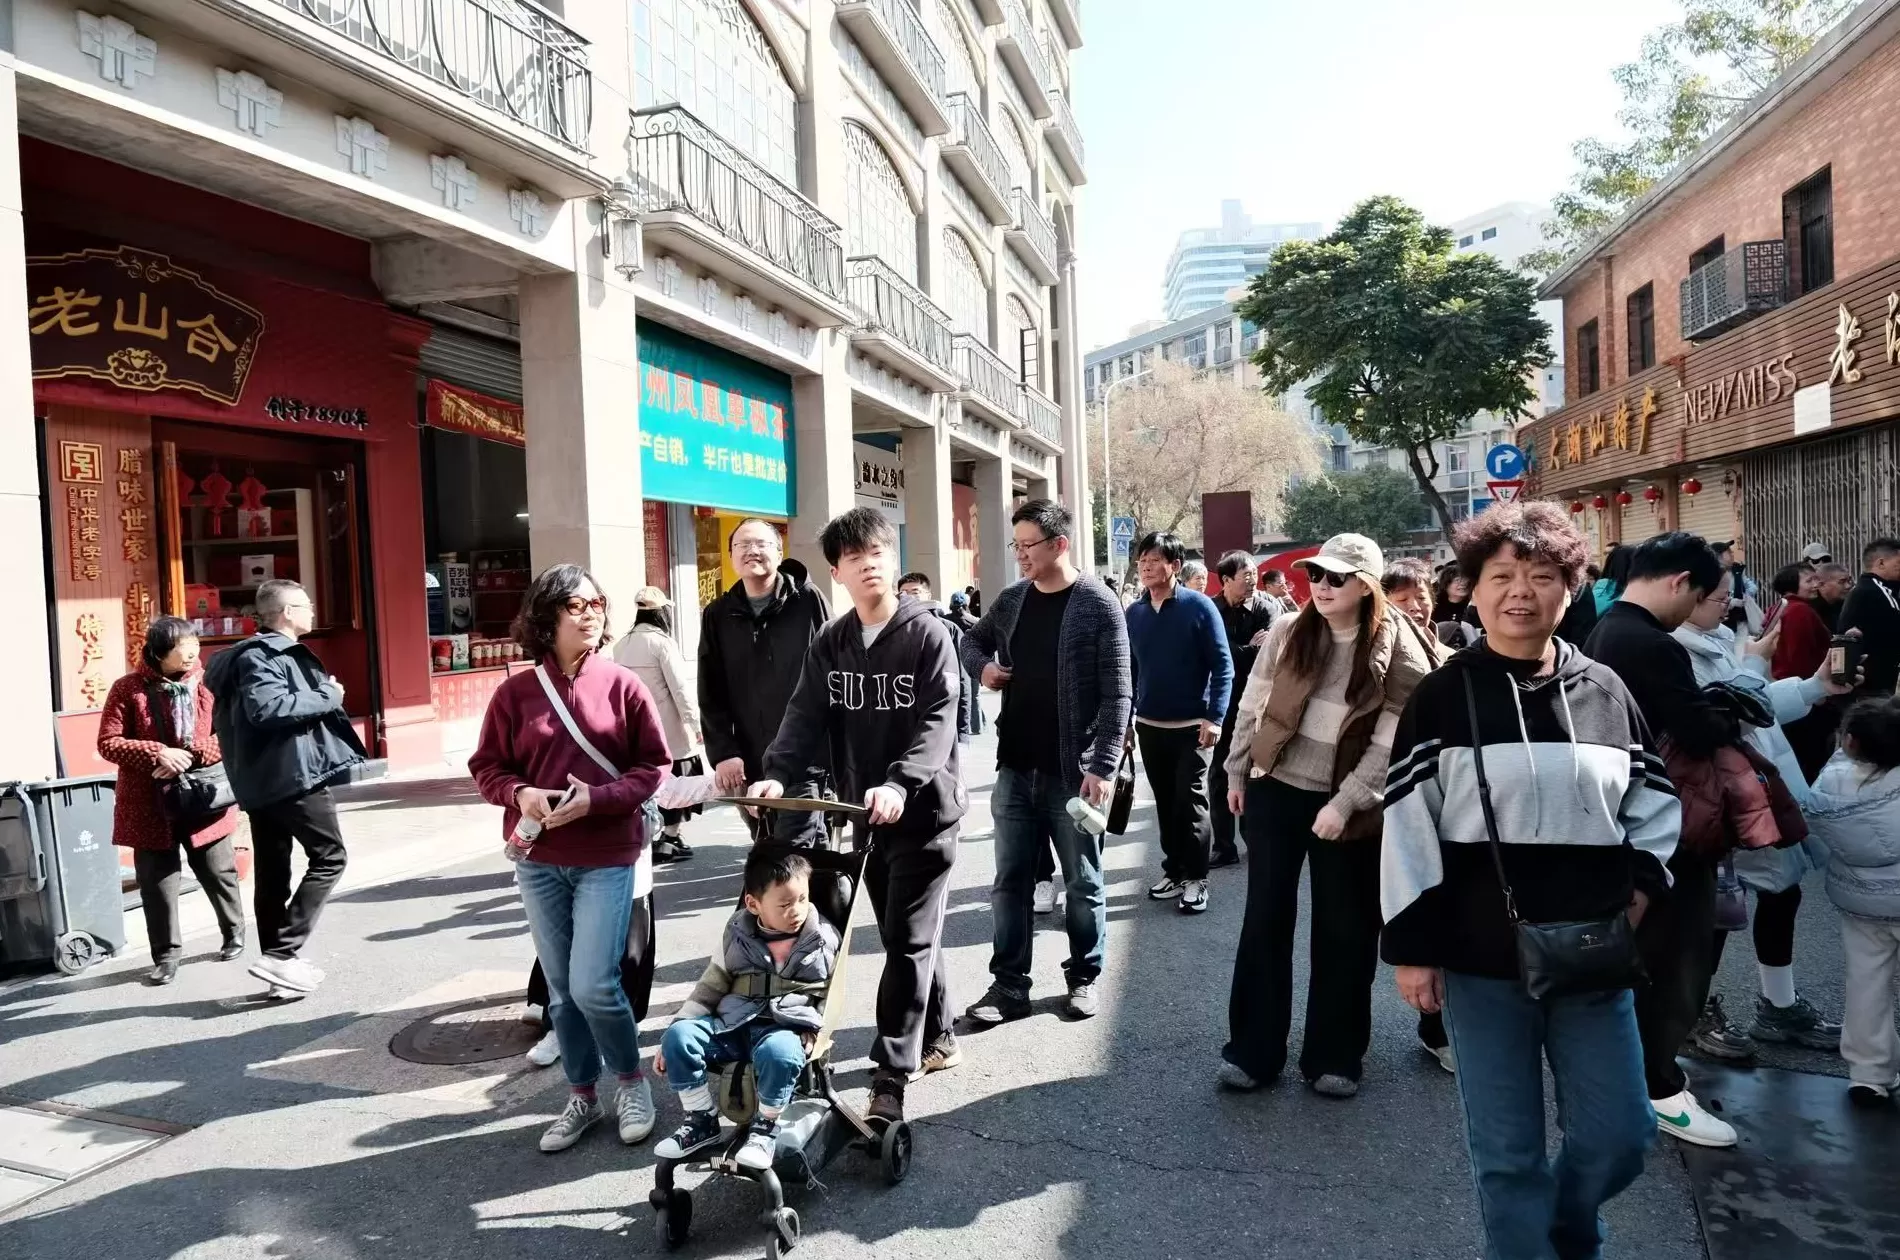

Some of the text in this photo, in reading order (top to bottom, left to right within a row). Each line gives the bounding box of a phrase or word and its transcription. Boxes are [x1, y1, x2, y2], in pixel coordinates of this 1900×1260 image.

[29, 286, 238, 364] 老山合
[68, 486, 77, 507] China
[80, 488, 103, 581] 中华老字号
